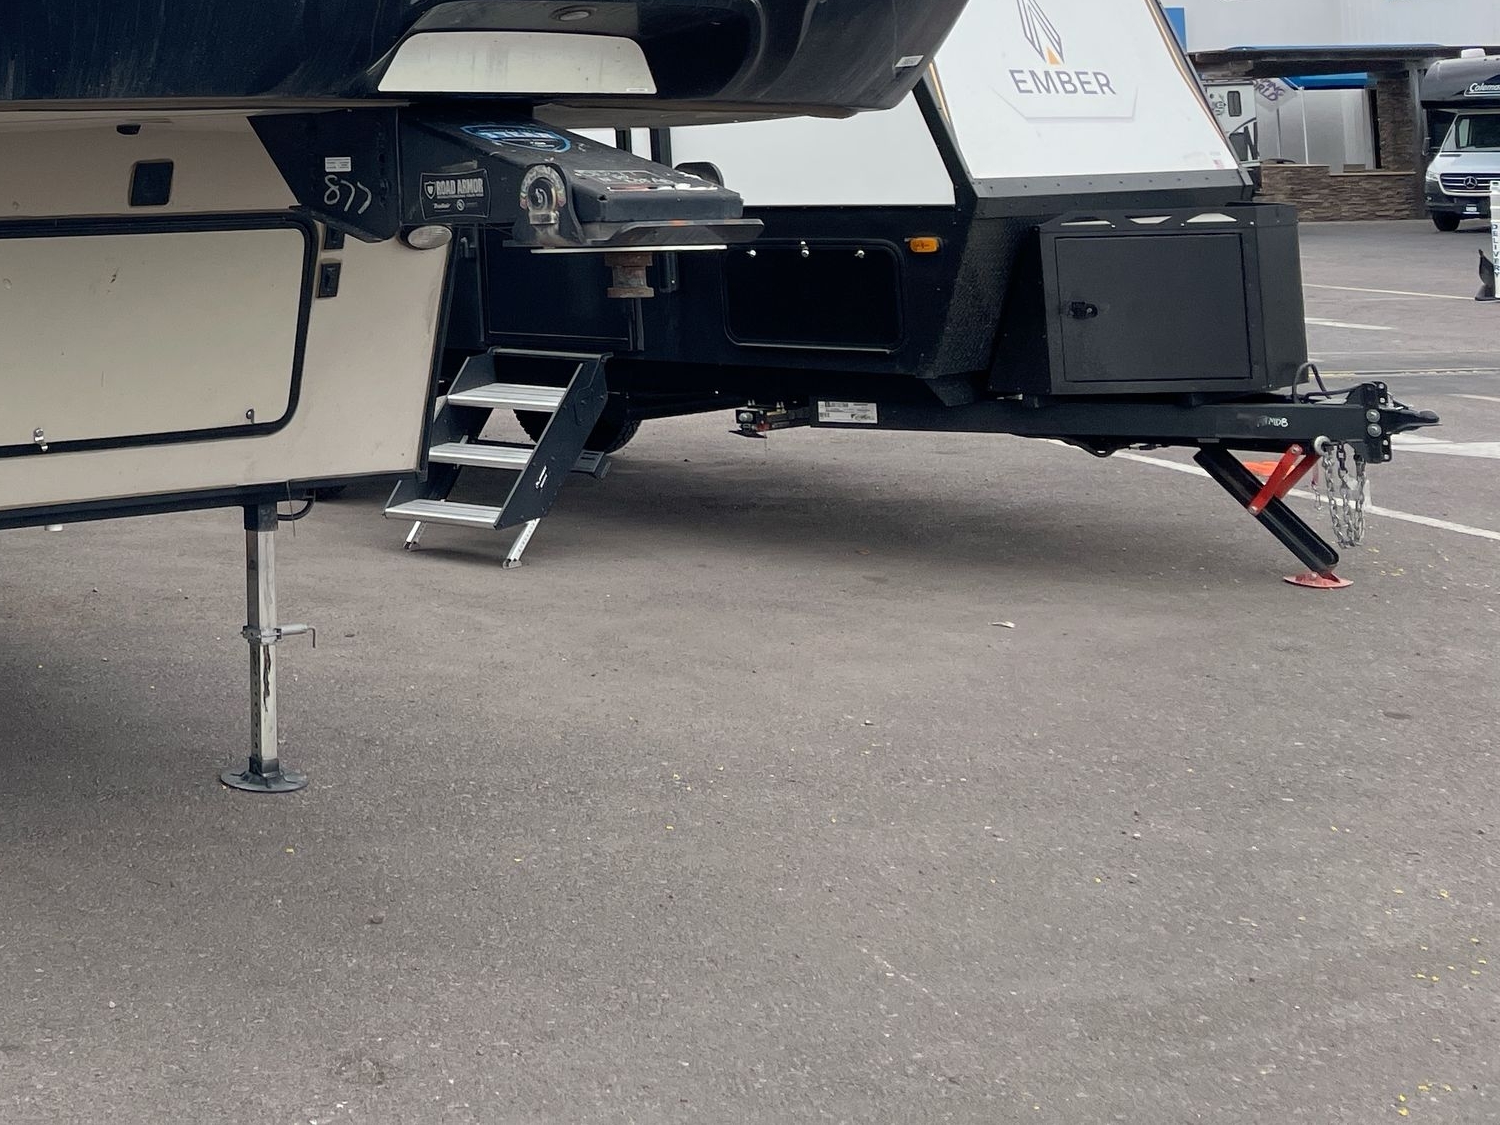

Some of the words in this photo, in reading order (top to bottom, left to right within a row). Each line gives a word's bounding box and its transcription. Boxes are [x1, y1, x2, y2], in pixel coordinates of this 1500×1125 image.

[1008, 69, 1116, 95] EMBER
[324, 175, 372, 214] 877
[436, 180, 456, 195] ROAD
[457, 178, 484, 194] ARMOR
